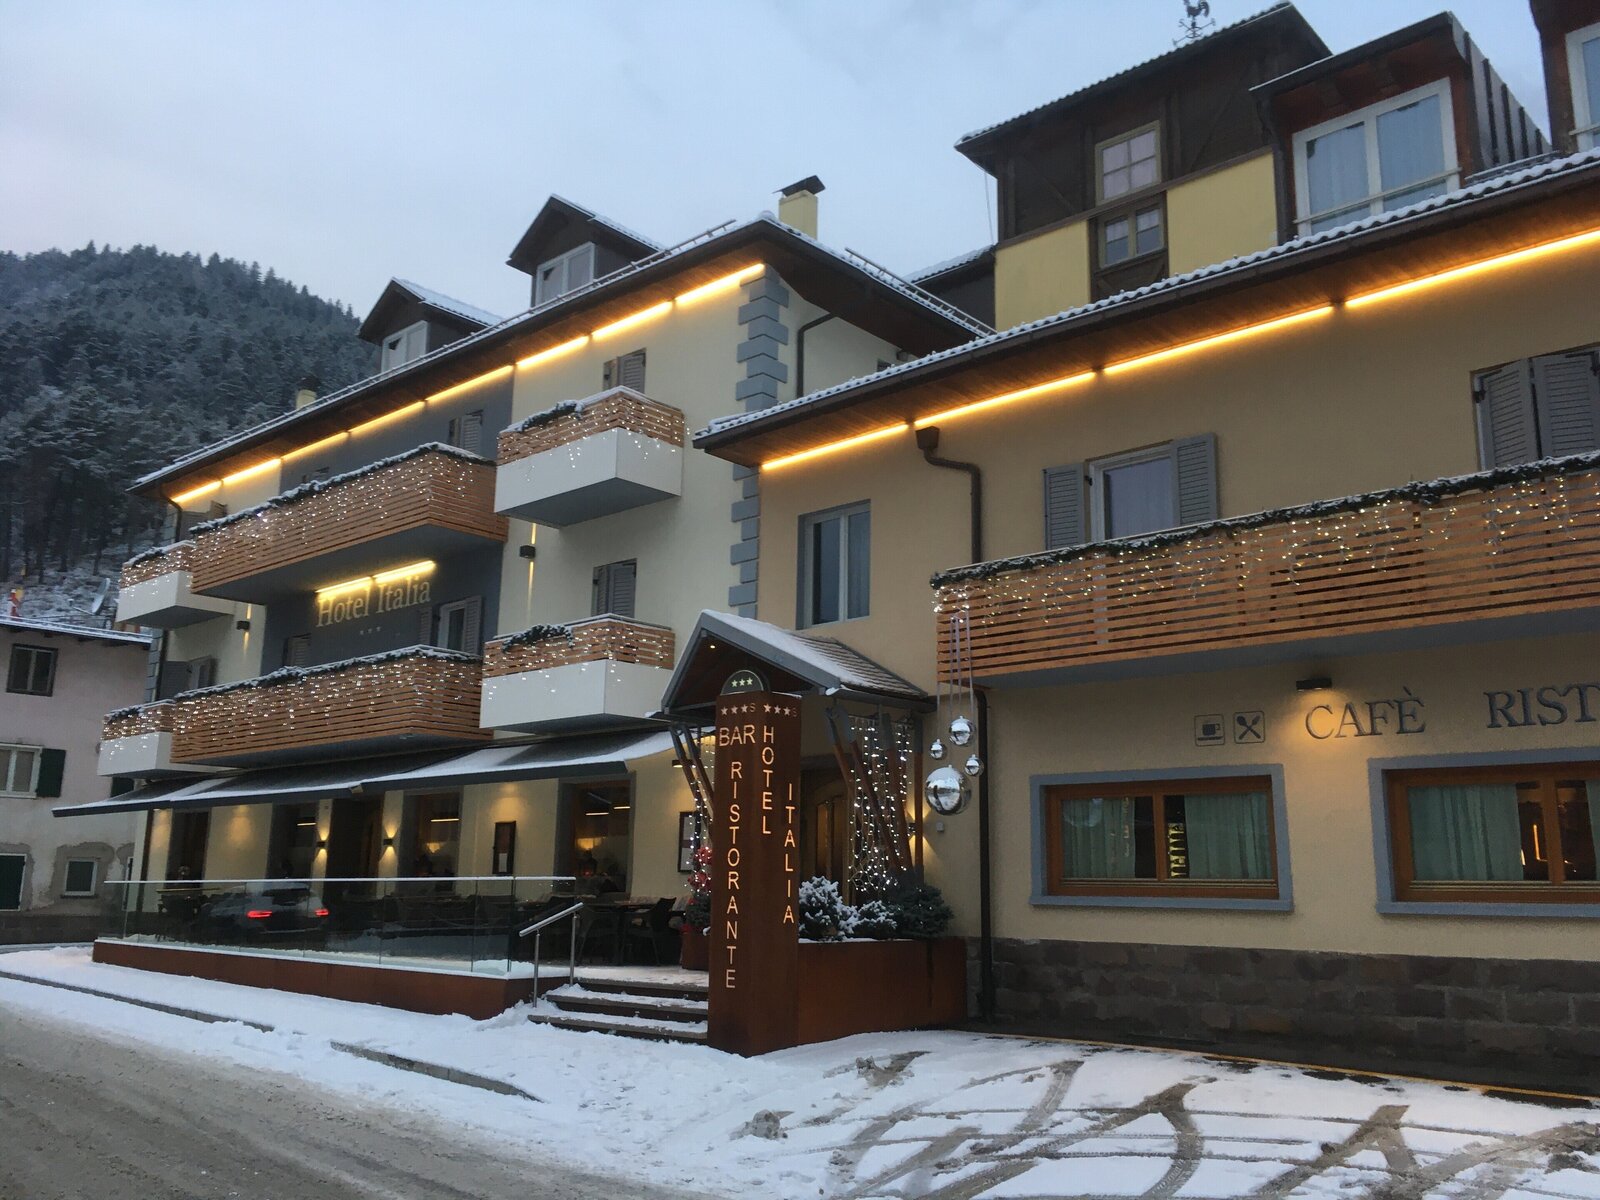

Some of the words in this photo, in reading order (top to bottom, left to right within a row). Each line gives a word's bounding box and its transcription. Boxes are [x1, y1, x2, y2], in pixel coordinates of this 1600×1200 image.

[316, 587, 370, 627] Hotel
[376, 575, 430, 613] Italia
[719, 724, 756, 747] BAR
[1305, 686, 1426, 739] CAFÈ
[1483, 682, 1600, 728] RIST
[762, 725, 774, 834] HOTEL
[725, 761, 743, 989] RISTORANTE
[783, 783, 796, 924] ITALIA
